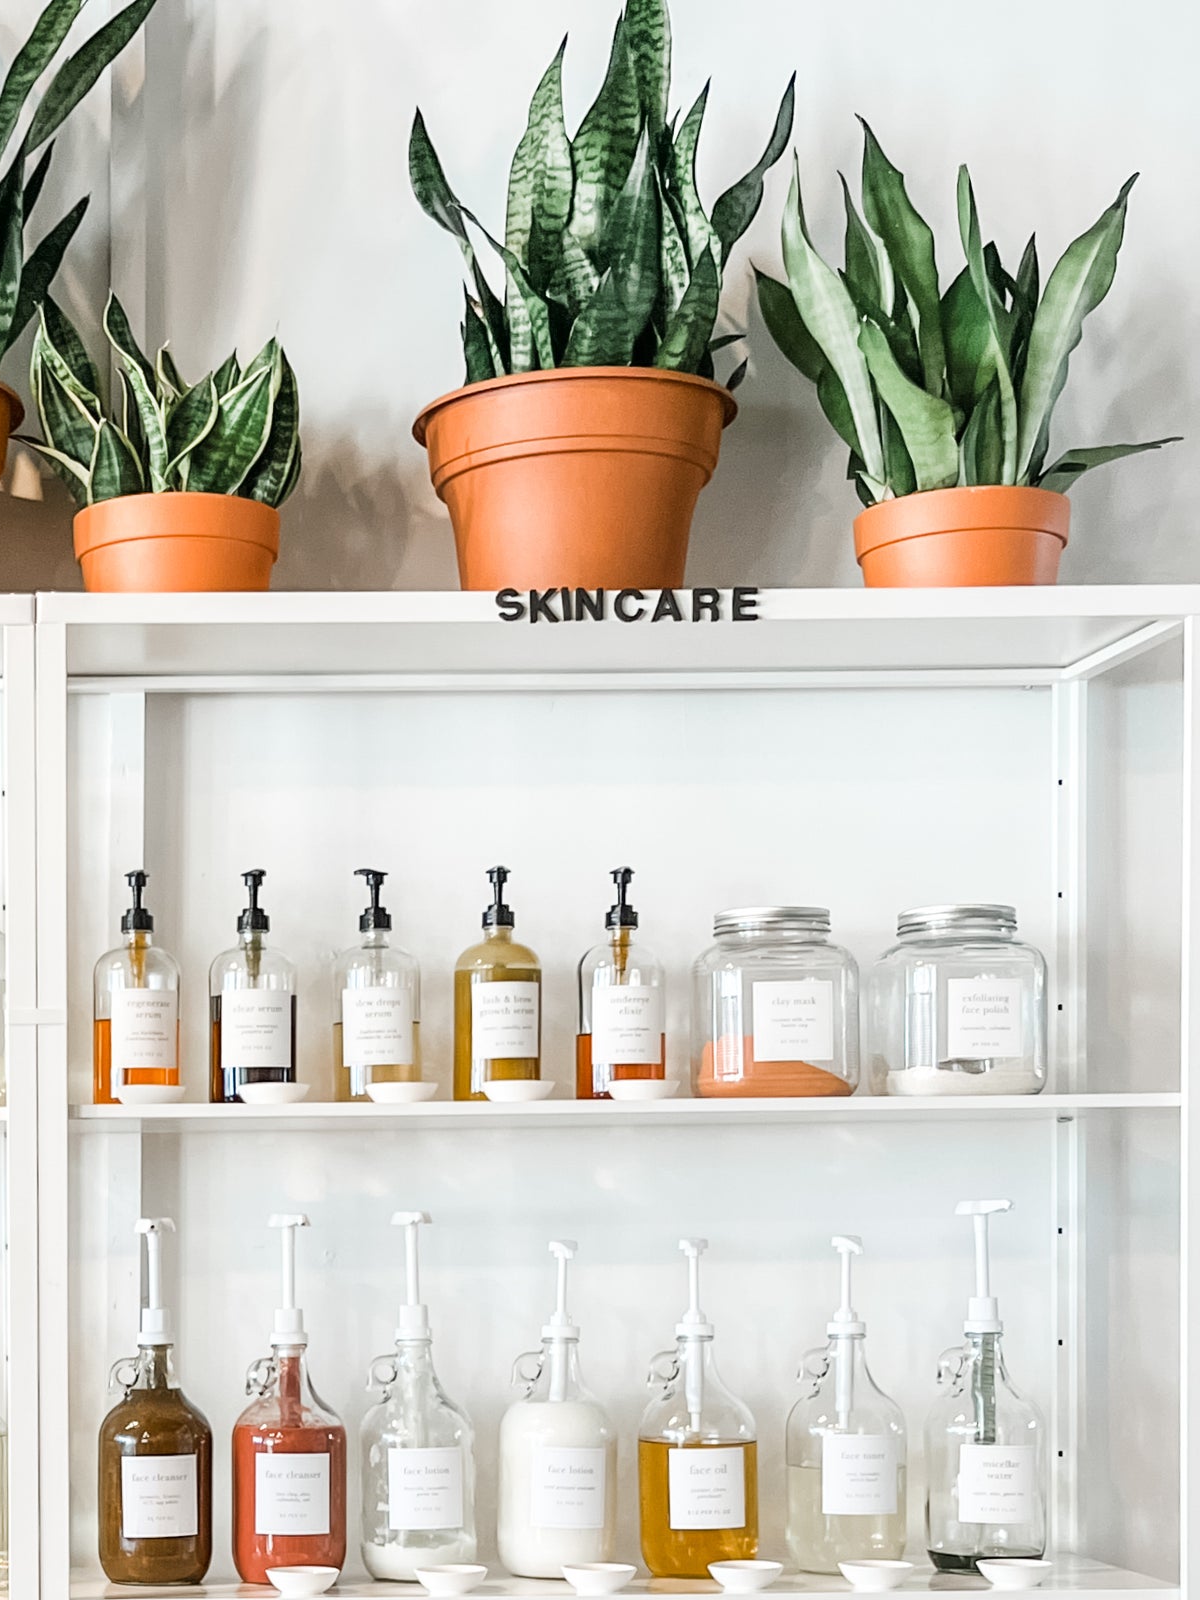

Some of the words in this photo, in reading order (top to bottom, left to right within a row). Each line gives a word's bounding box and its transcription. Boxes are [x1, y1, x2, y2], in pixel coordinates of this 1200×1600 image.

[495, 587, 759, 624] SKINCARE
[503, 995, 511, 1004] &
[610, 996, 649, 1006] undereye
[772, 997, 790, 1006] clay
[793, 997, 816, 1005] mask
[962, 993, 1010, 1004] exfoliating
[127, 1000, 171, 1009] regenerate
[376, 998, 401, 1009] drops
[480, 1007, 511, 1017] growth
[962, 1005, 980, 1015] face
[982, 1005, 1010, 1015] polish
[841, 1452, 860, 1460] face
[982, 1459, 1021, 1469] micellar
[403, 1466, 421, 1475] face
[424, 1466, 450, 1475] lotion
[547, 1465, 565, 1474] face
[569, 1465, 594, 1474] lotion
[689, 1465, 711, 1475] face
[714, 1464, 728, 1475] oil
[131, 1473, 149, 1482] face
[152, 1473, 188, 1481] cleanser
[265, 1470, 282, 1479] face
[285, 1470, 321, 1479] cleanser
[987, 1472, 1013, 1480] water
